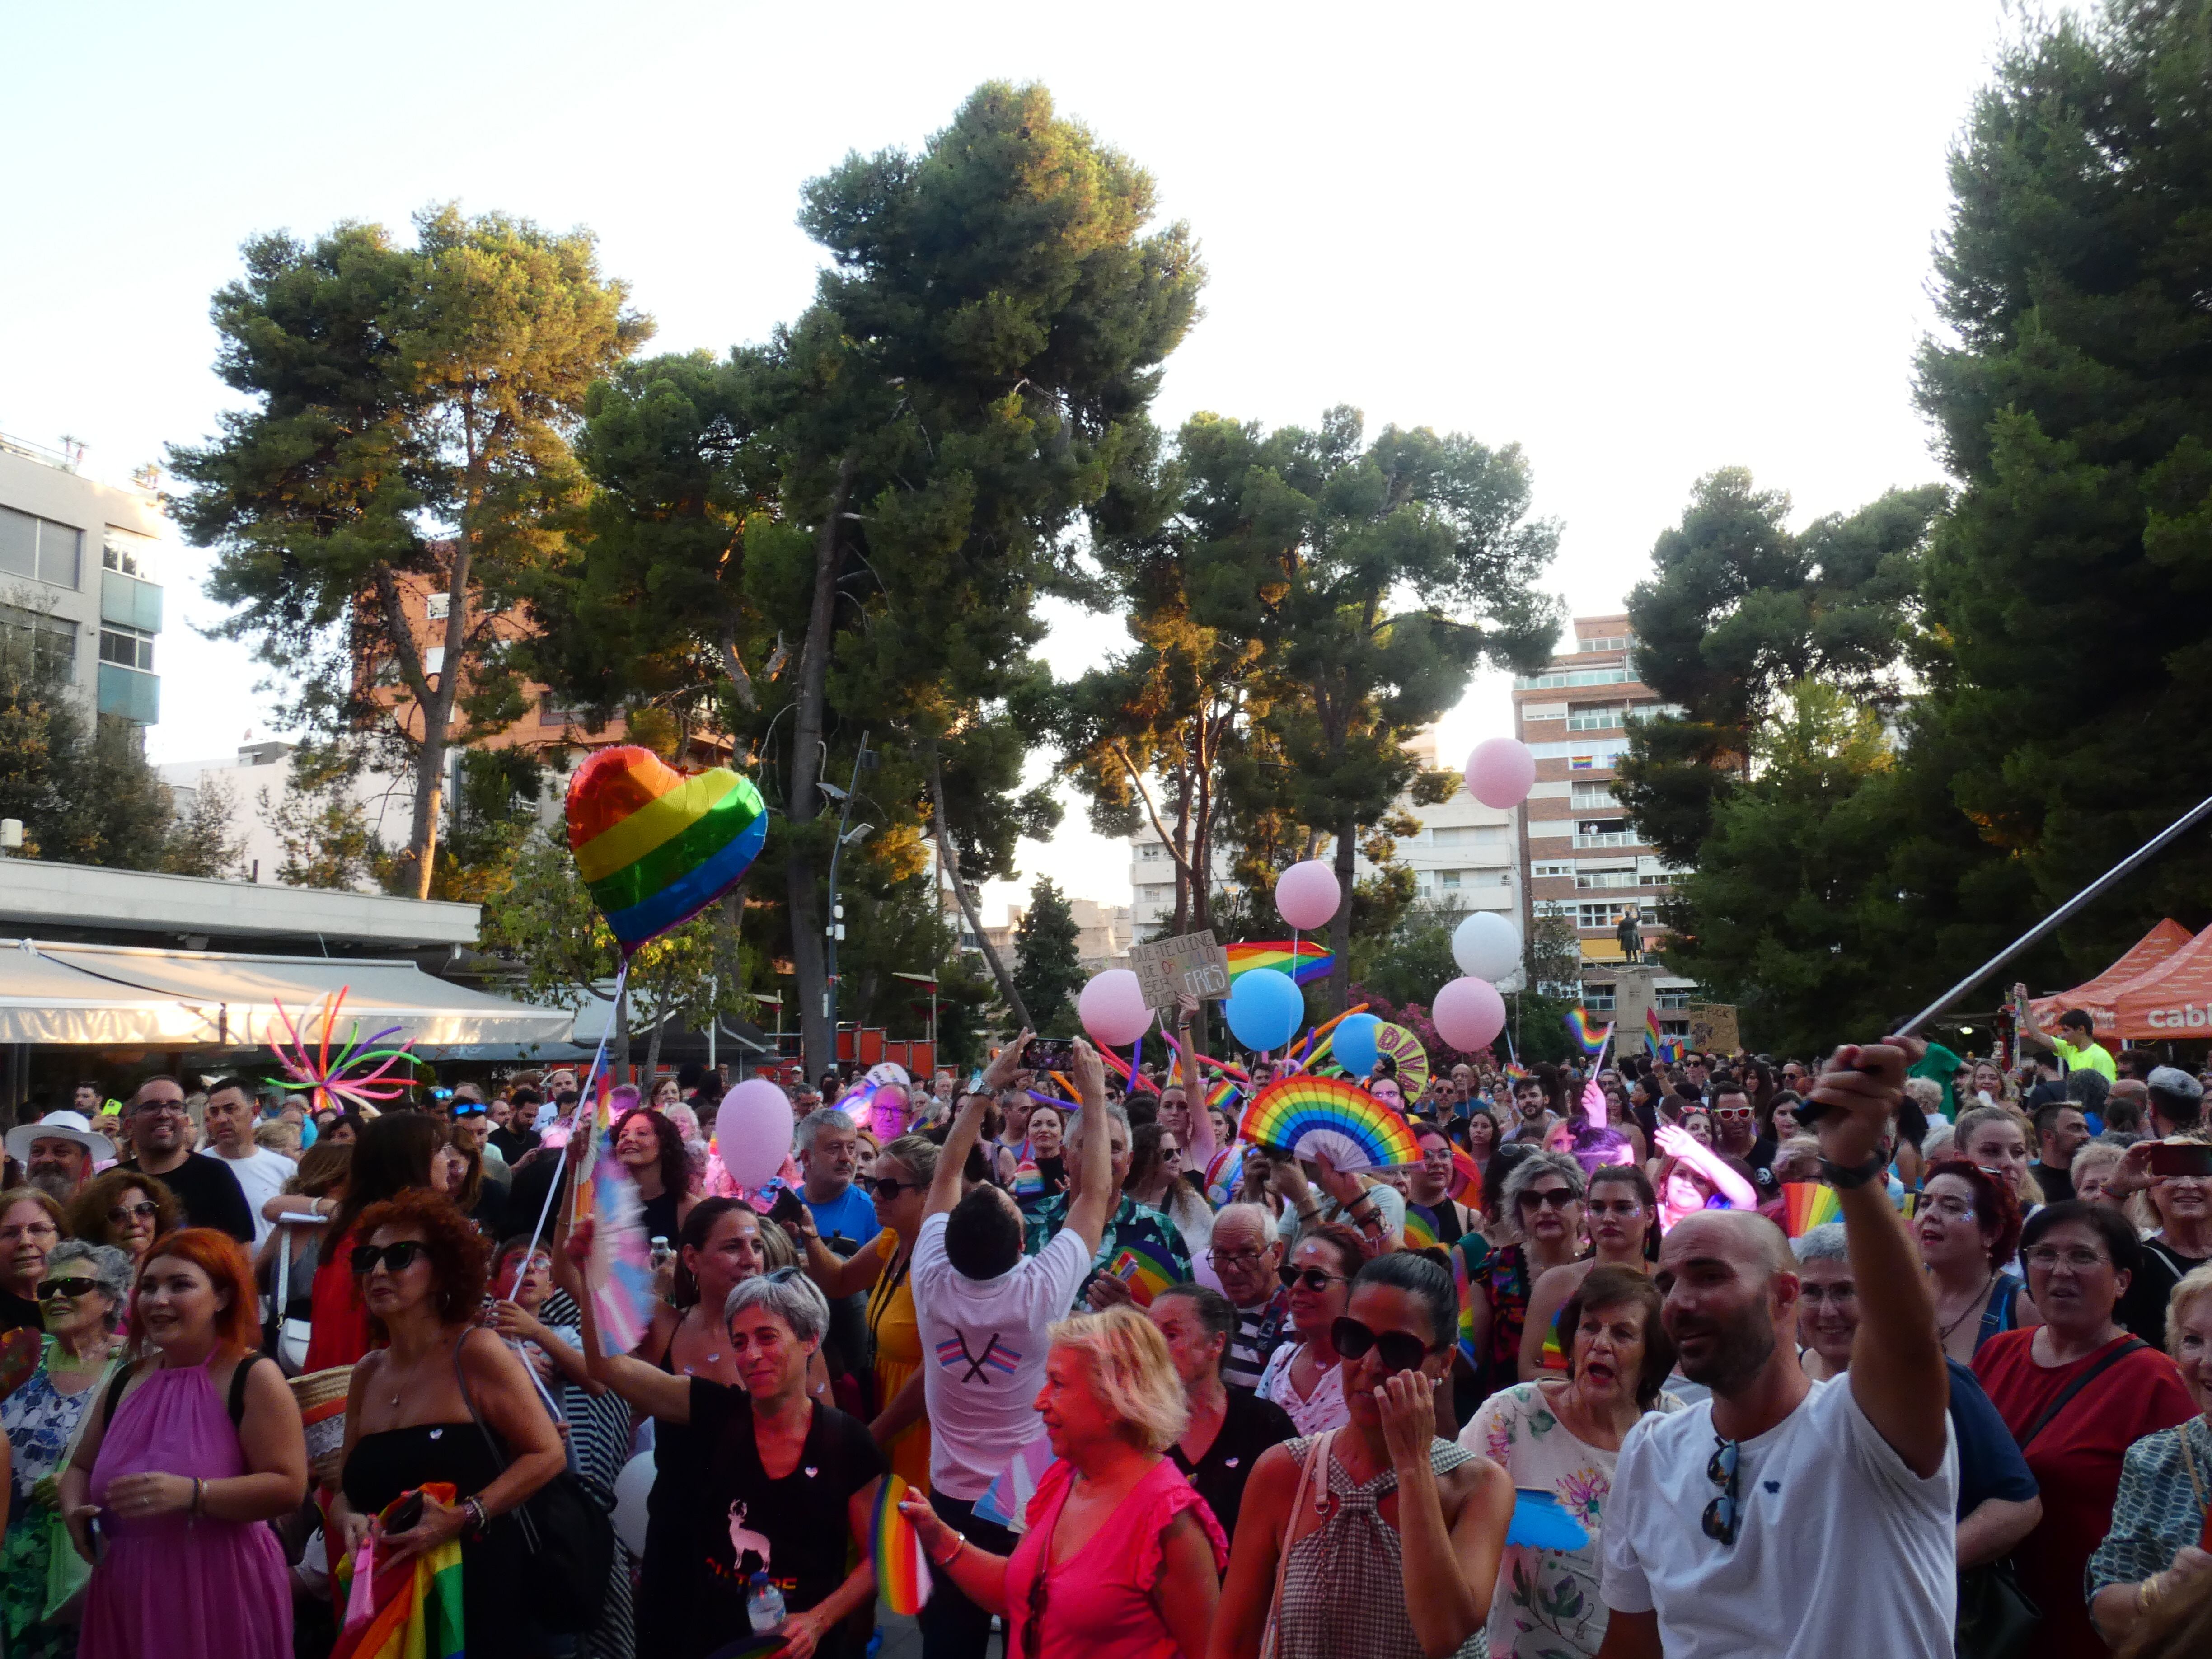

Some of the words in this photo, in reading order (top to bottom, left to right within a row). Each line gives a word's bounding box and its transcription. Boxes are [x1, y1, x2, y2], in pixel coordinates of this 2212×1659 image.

[1131, 946, 1155, 963] QUE
[1157, 942, 1175, 956] TE
[1175, 932, 1213, 954] LLENE
[1143, 964, 1158, 978] DE
[1143, 978, 1173, 994] SER
[1183, 965, 1226, 996] ERES
[1378, 1026, 1425, 1092] DIVA
